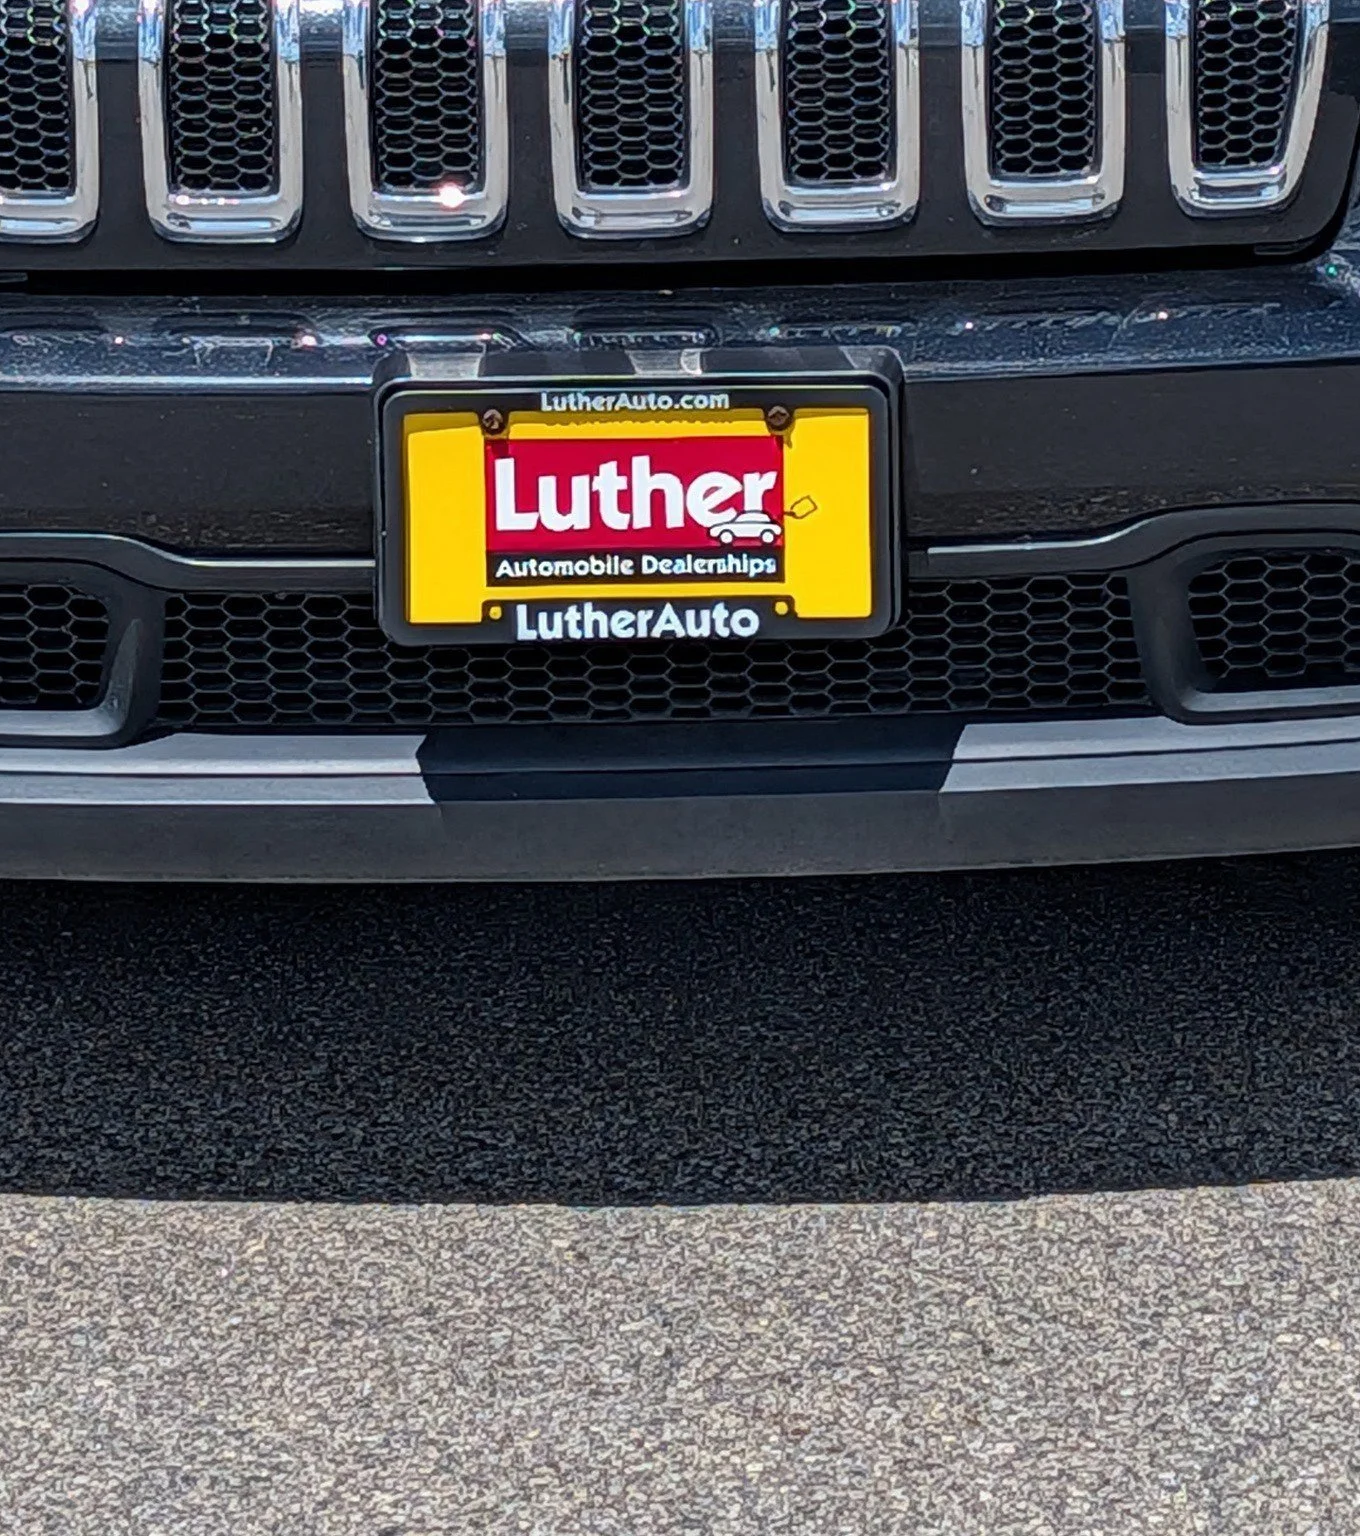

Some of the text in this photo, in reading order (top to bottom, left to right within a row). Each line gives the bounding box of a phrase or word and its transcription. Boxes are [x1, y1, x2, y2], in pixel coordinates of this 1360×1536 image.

[541, 391, 730, 412] LutherAuto.com
[494, 455, 777, 532] Luther
[495, 554, 634, 578] Automobile
[516, 602, 760, 641] LutherAuto
